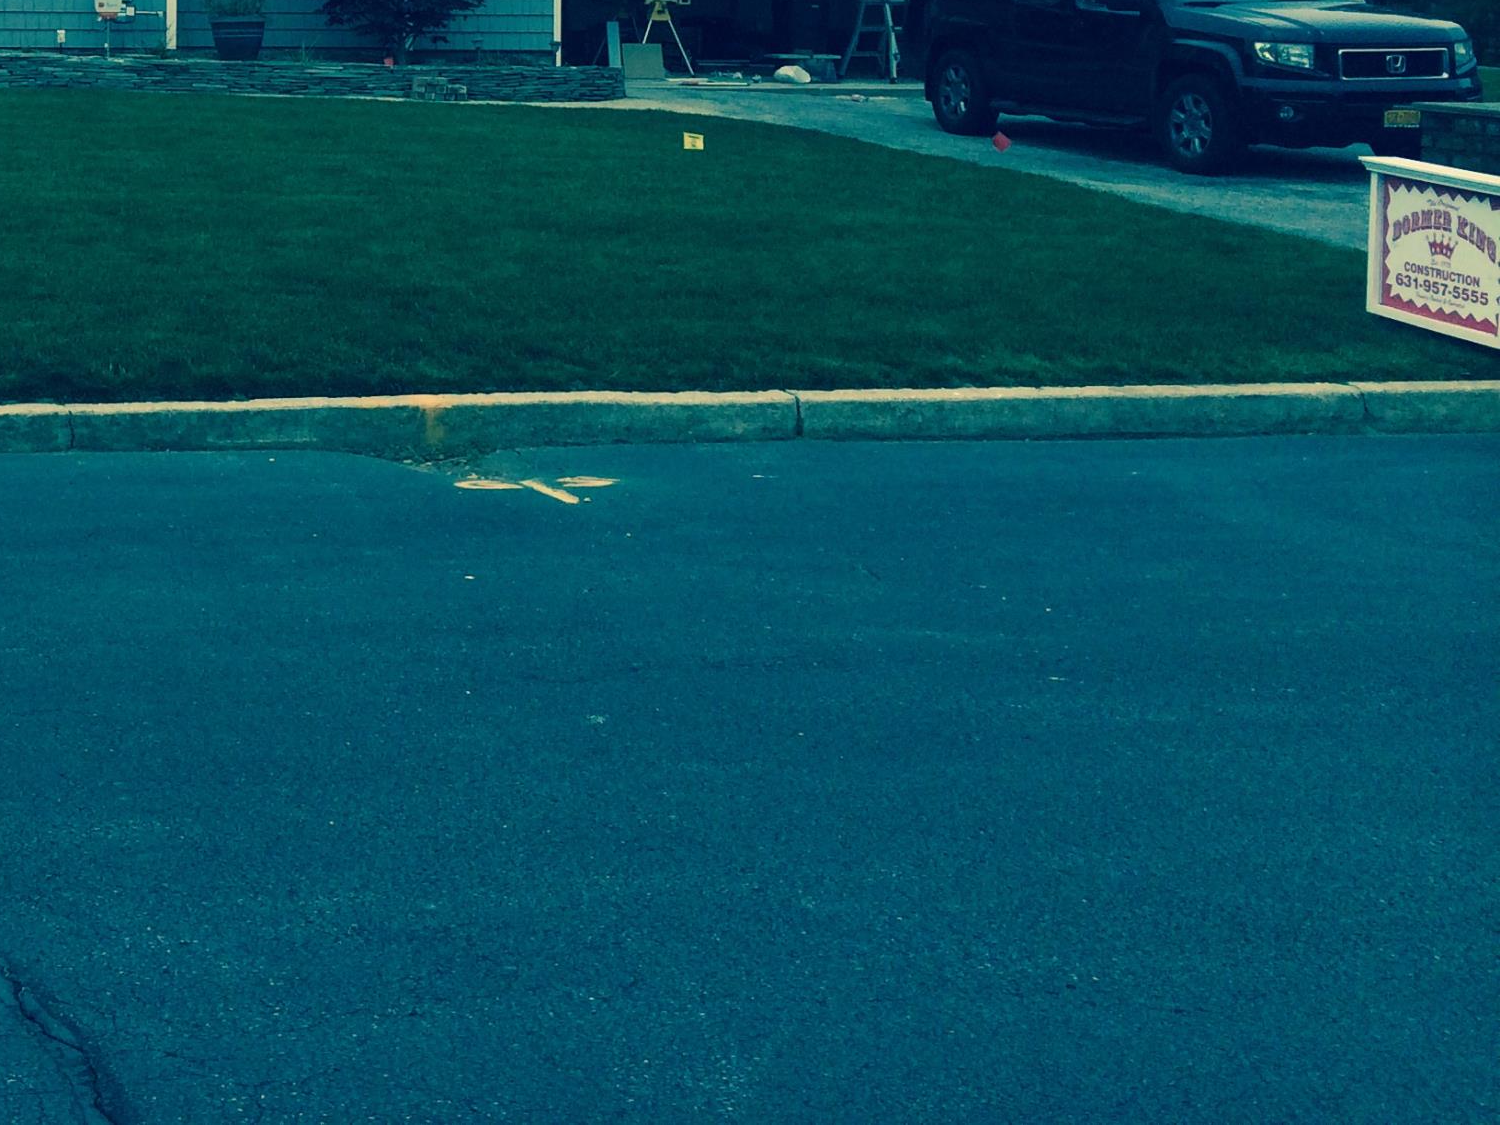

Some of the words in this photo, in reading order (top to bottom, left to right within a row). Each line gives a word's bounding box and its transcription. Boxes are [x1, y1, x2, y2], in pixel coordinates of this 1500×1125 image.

[1392, 209, 1452, 242] DORMER
[1457, 215, 1496, 263] KING
[1404, 261, 1480, 287] CONSTRUCTION
